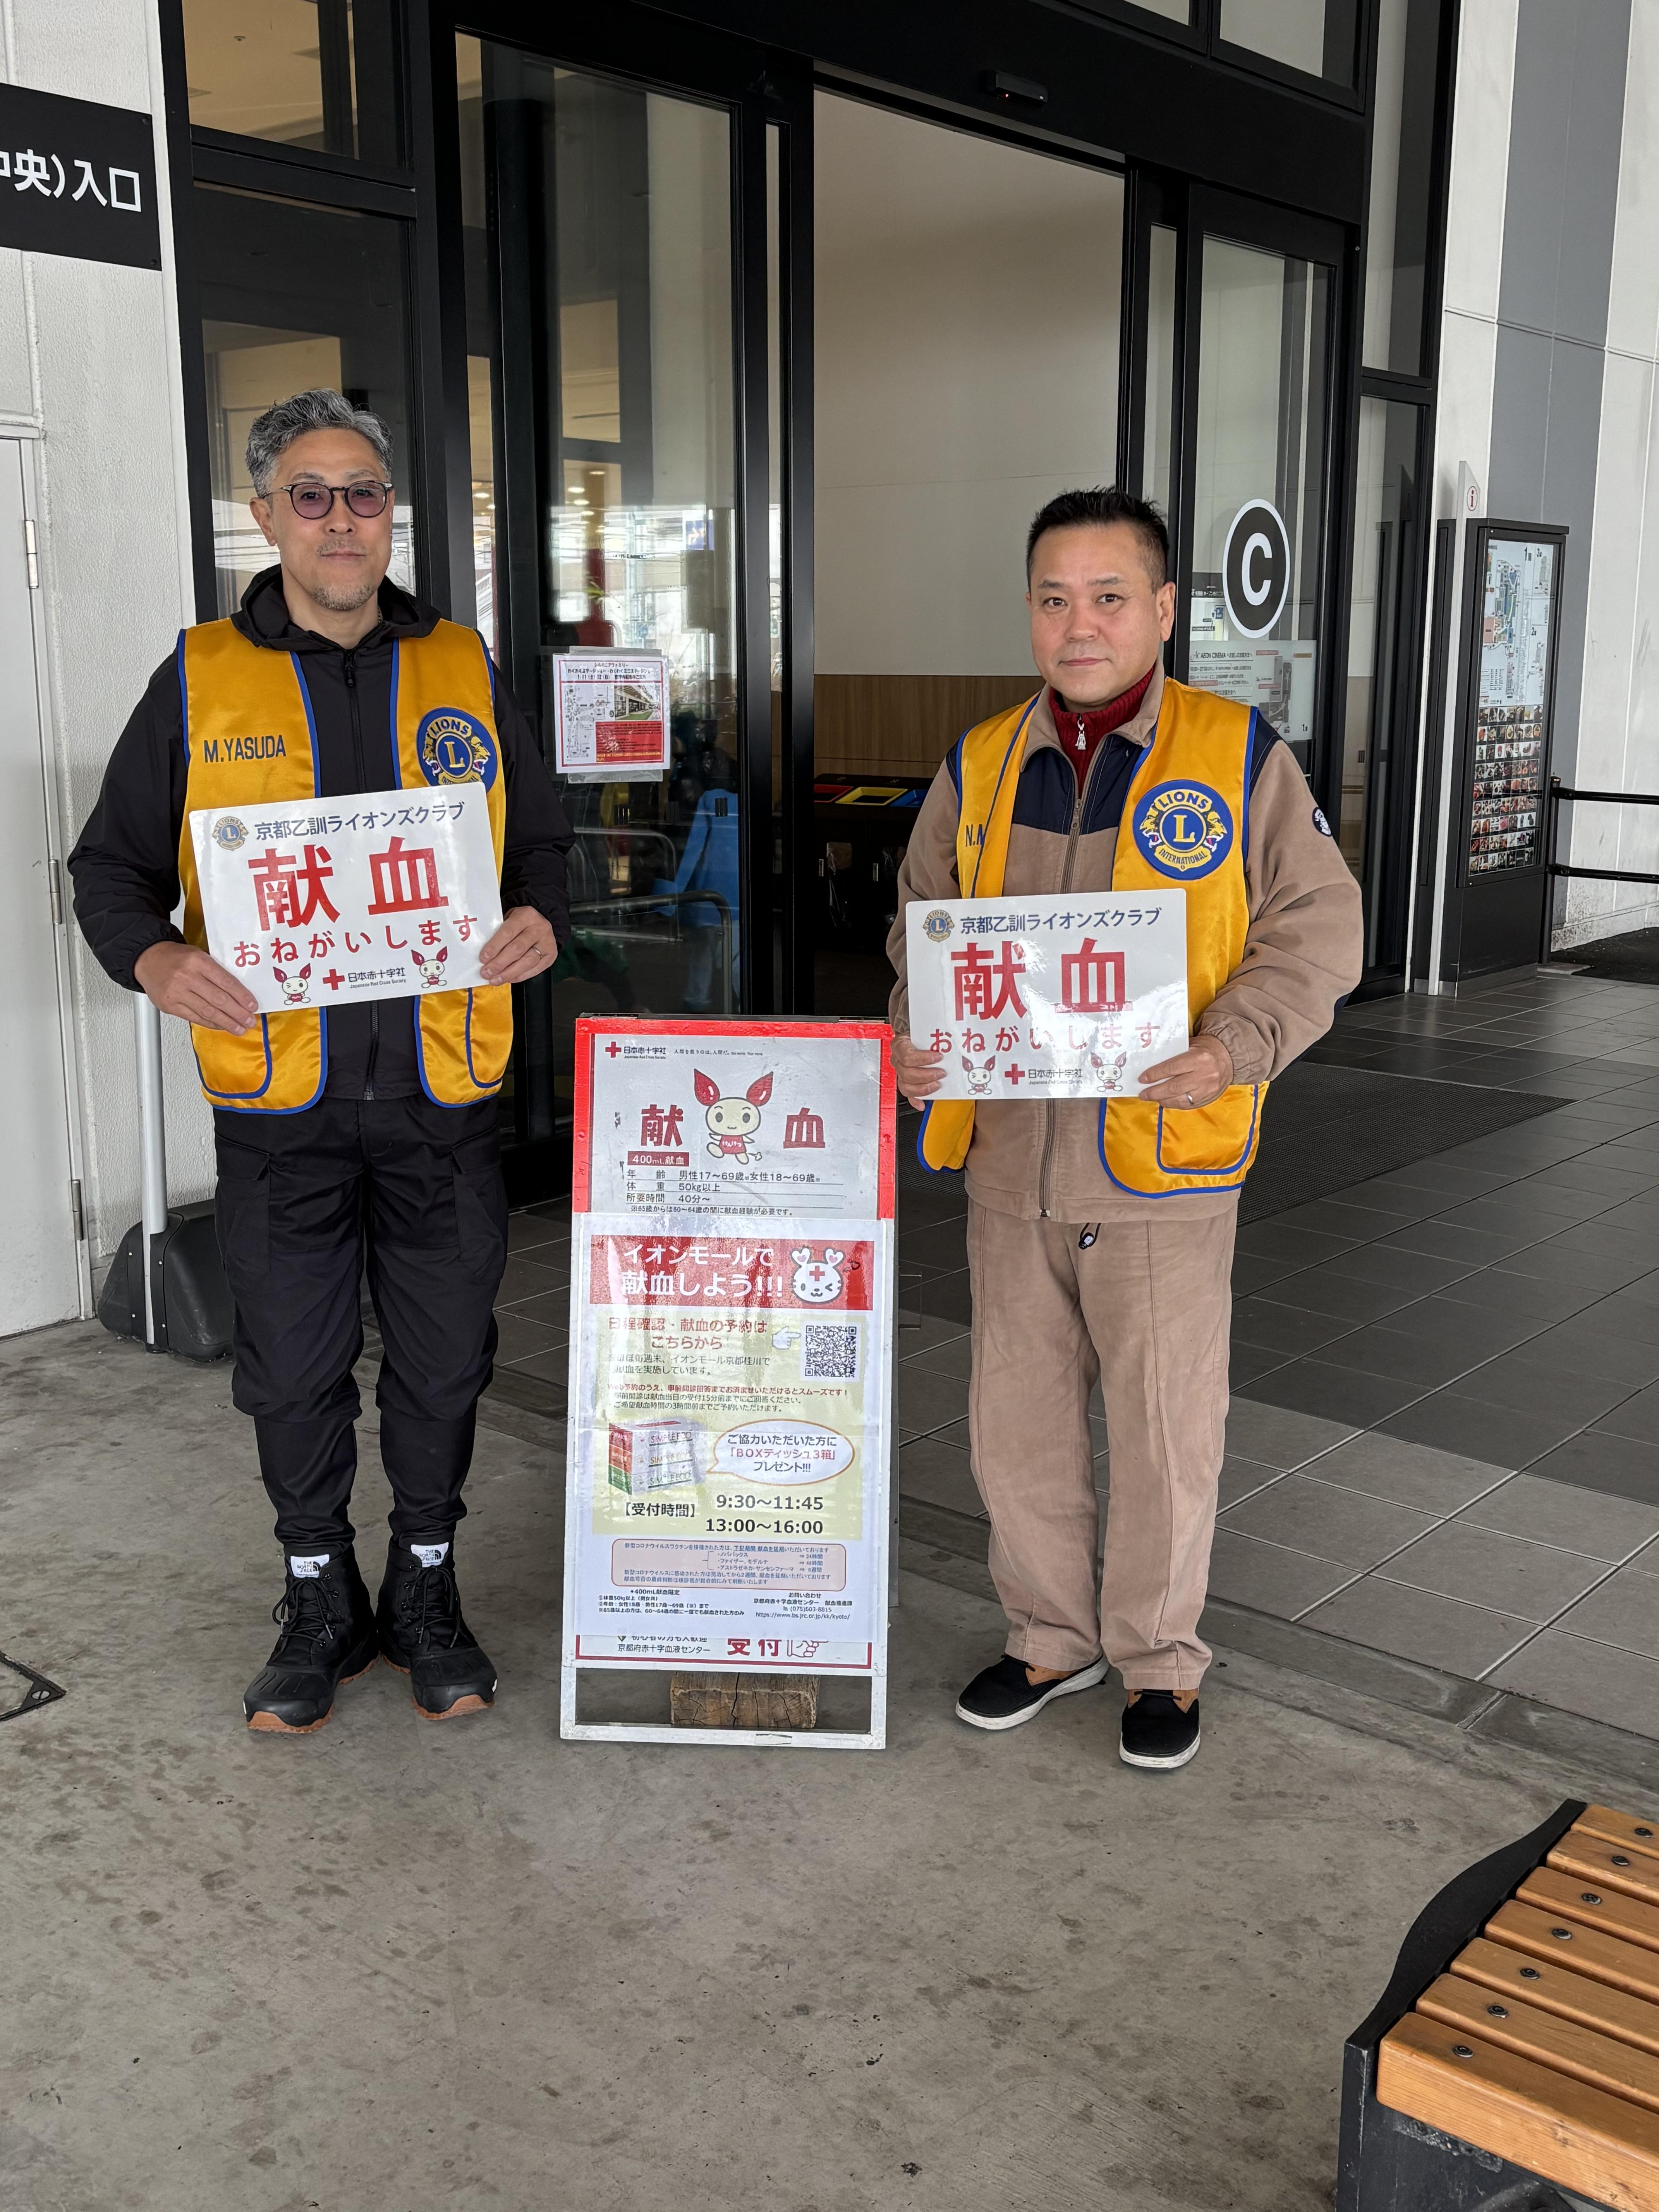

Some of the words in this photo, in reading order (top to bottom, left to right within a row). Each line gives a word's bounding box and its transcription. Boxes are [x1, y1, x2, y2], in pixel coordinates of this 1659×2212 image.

[1242, 532, 1272, 606] C
[430, 719, 469, 735] LIONS
[204, 735, 286, 763] M.YASUDA
[444, 741, 465, 768] L
[1158, 792, 1209, 809] LIONS
[255, 802, 465, 841] 京都乙訓ライオンズクラブ
[1173, 815, 1195, 843] L
[225, 827, 236, 839] L
[1158, 848, 1207, 864] INTERNATIONAL
[960, 907, 1162, 934] 京都乙訓ライオンズクラブ
[234, 915, 478, 968] おねがいします
[348, 967, 406, 982] 日本赤十字社
[1029, 1068, 1083, 1078] 日本赤十字社
[678, 1183, 720, 1192] 50kg以上
[626, 1193, 665, 1203] 所要時間
[623, 1243, 774, 1267] イオンモールで
[651, 1336, 723, 1350] こちらから
[728, 1434, 837, 1446] ご協力いただいた方に
[626, 1502, 696, 1518] 【受付時間】
[618, 1644, 711, 1654] 京都府赤十字血液センター
